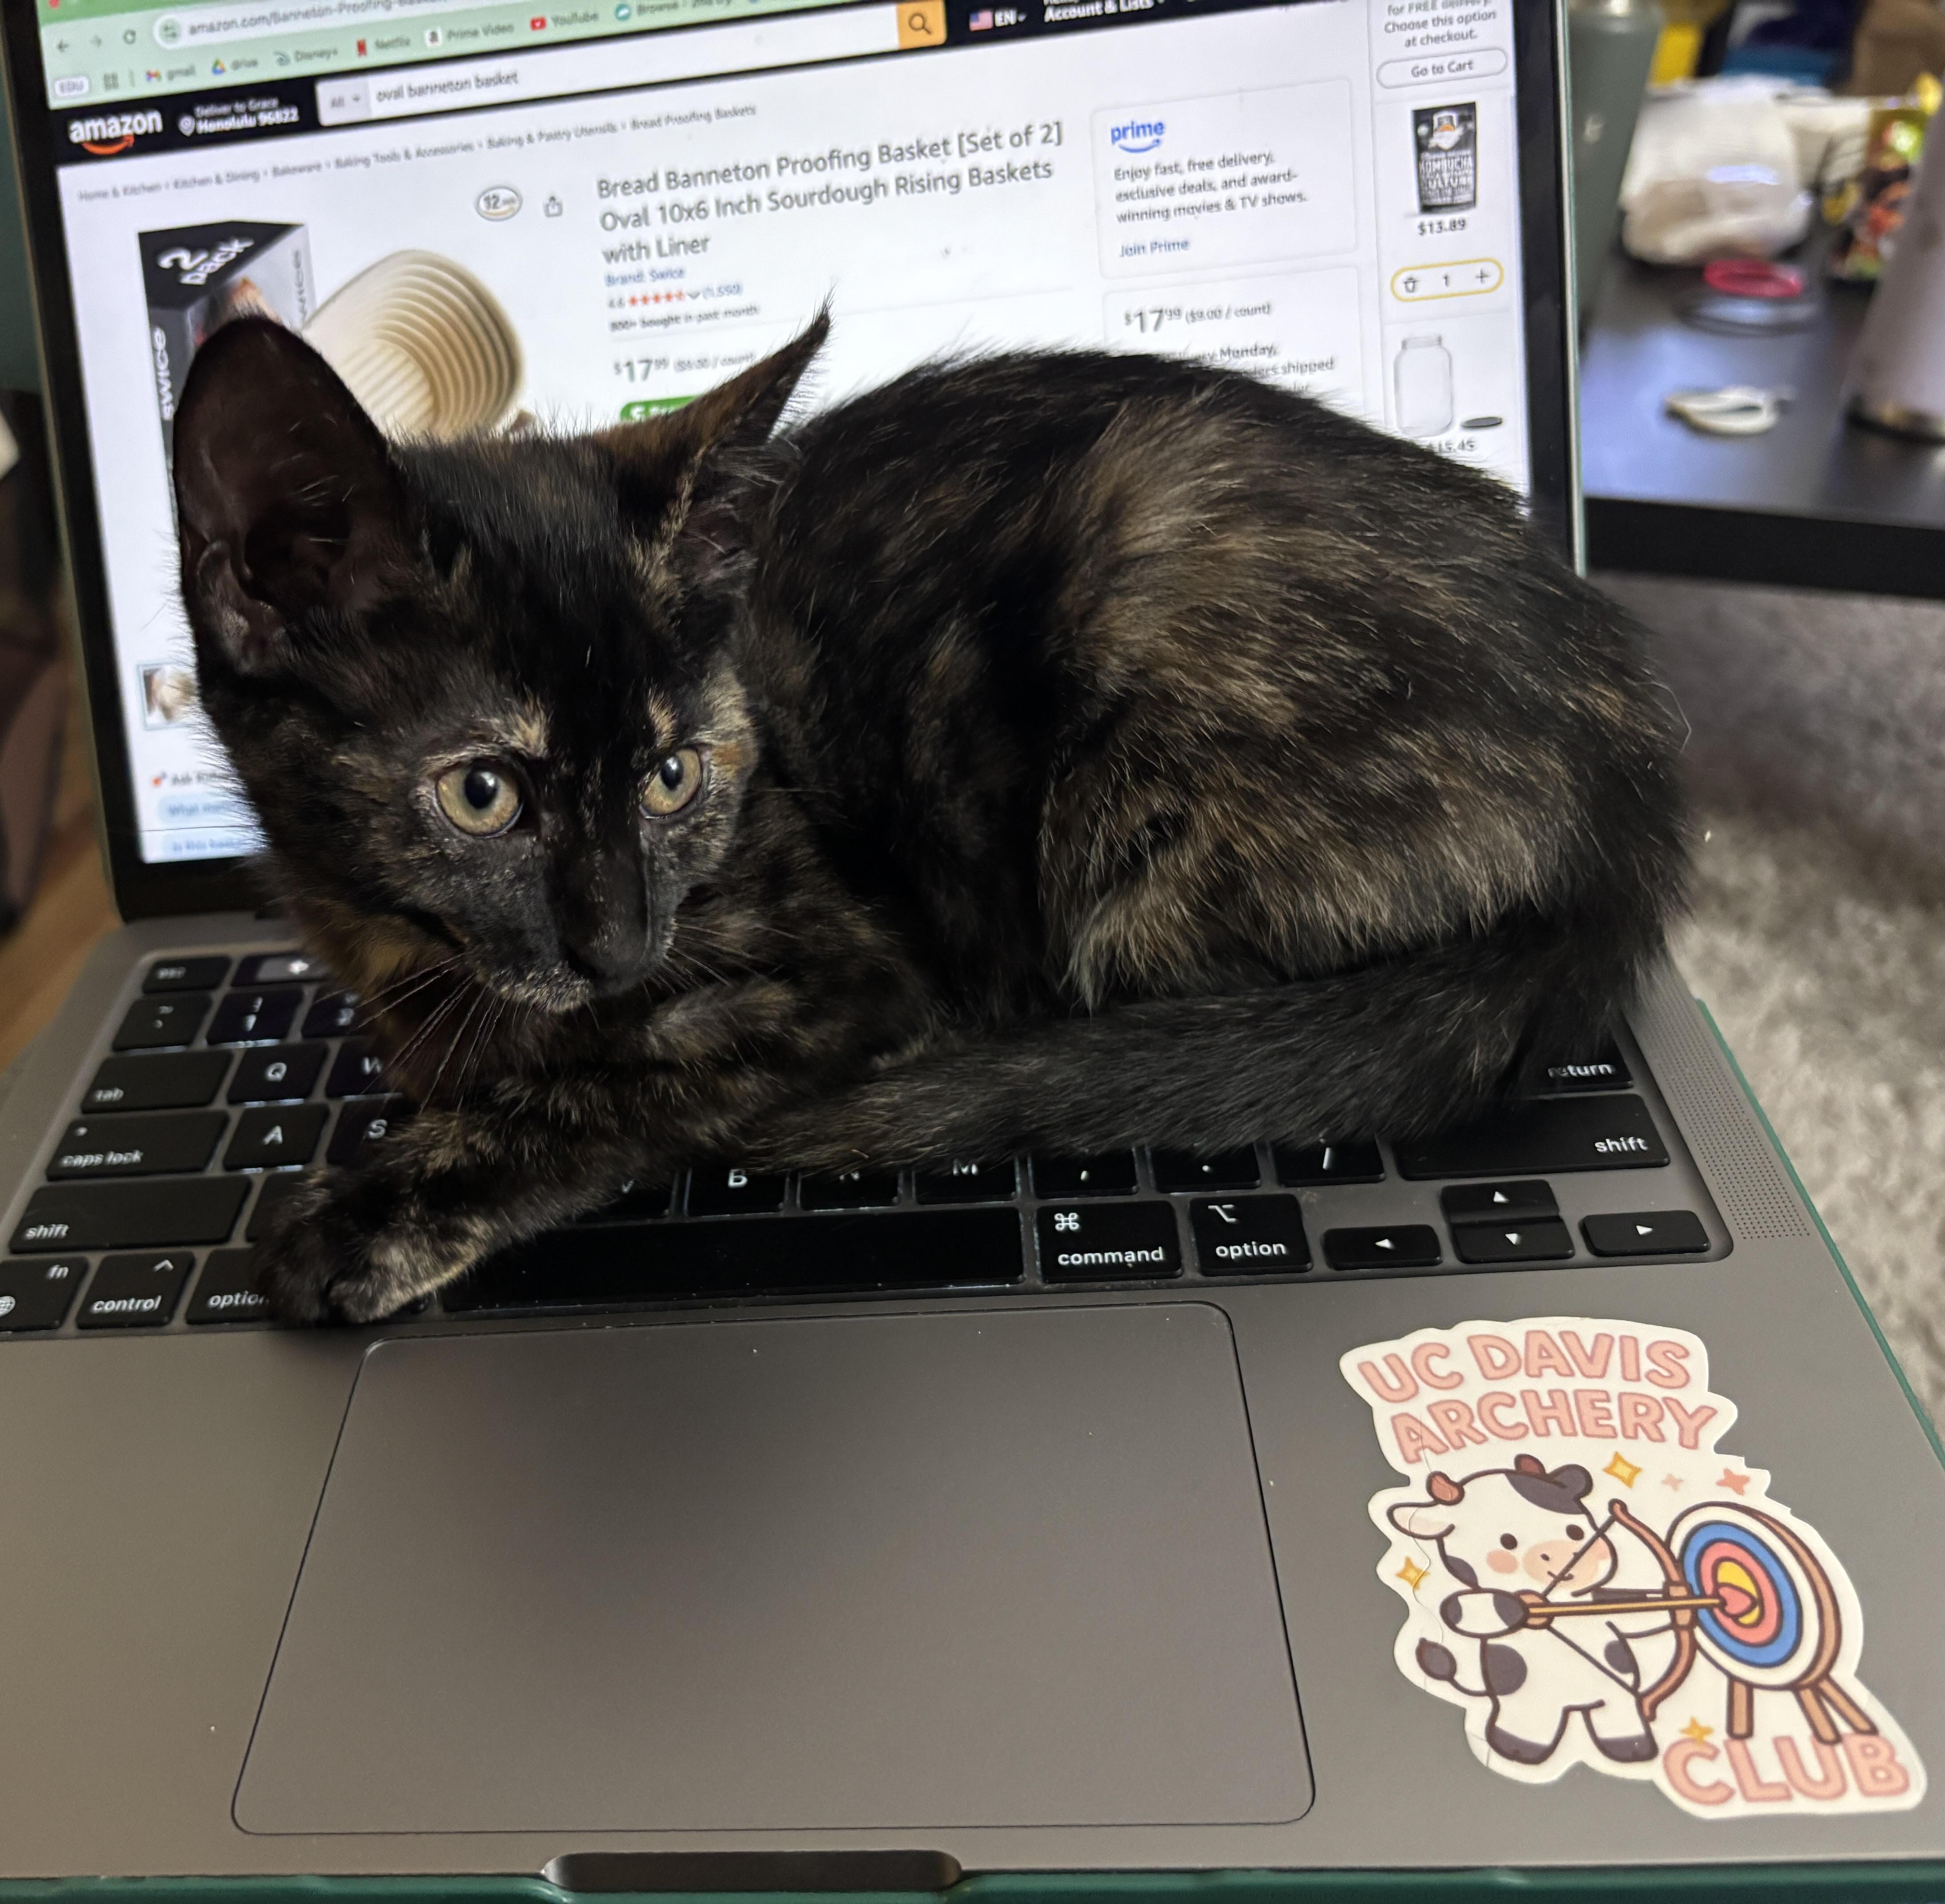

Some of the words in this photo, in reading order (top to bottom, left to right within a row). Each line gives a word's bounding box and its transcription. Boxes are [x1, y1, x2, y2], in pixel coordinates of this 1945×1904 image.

[994, 9, 1017, 27] EN
[1044, 2, 1103, 23] Account
[1105, 1, 1116, 14] &
[1387, 4, 1405, 16] for
[1408, 1, 1438, 14] FREE
[551, 12, 599, 27] YouTube
[1384, 19, 1428, 33] Choose
[1431, 15, 1454, 28] this
[1456, 10, 1497, 25] option
[446, 27, 479, 41] Prime
[480, 22, 514, 36] Video
[1404, 36, 1418, 48] at
[1419, 28, 1478, 46] checkout.
[1411, 64, 1428, 78] Go
[1431, 64, 1444, 75] to
[1447, 60, 1474, 73] Cart
[376, 87, 404, 103] oval
[406, 76, 473, 98] banneton
[474, 69, 519, 88] basket
[194, 103, 232, 117] Deliver
[233, 102, 246, 113] to
[68, 110, 163, 143] amazon
[196, 116, 257, 134] Honolulu
[1110, 119, 1165, 144] prime
[597, 172, 659, 199] Bread
[665, 160, 770, 189] Banneton
[777, 148, 871, 177] Proofing
[878, 137, 952, 164] Basket
[958, 131, 1002, 159] [Set
[1010, 125, 1034, 148] of
[1040, 120, 1063, 147] 2]
[1114, 167, 1151, 183] Enjoy
[1154, 162, 1182, 177] fast,
[1187, 158, 1214, 173] free
[1218, 150, 1275, 169] delivery,
[78, 189, 108, 202] Home
[122, 183, 162, 197] Kitchen
[173, 176, 213, 190] Kitchen
[225, 170, 260, 184] Dining
[1115, 184, 1175, 202] exclusive
[1178, 179, 1217, 197] deals,
[1221, 176, 1246, 191] and
[1250, 169, 1298, 187] award-
[483, 194, 500, 210] 12
[600, 206, 651, 232] Oval
[659, 200, 709, 224] 10x6
[715, 192, 762, 218] Inch
[767, 179, 888, 212] Sourdough
[895, 171, 962, 196] Rising
[968, 160, 1053, 188] Baskets
[1116, 206, 1170, 224] winning
[1173, 200, 1221, 216] movies
[1224, 197, 1235, 212] &
[1239, 195, 1258, 209] TV
[1261, 191, 1308, 206] shows.
[601, 240, 651, 264] with
[656, 234, 711, 258] Liner
[1119, 240, 1146, 258] Join
[1150, 238, 1190, 254] Prime
[158, 247, 208, 270] 2
[1443, 273, 1450, 288] 1
[639, 315, 682, 330] bought
[684, 313, 692, 323] in
[696, 311, 720, 324] past
[723, 304, 760, 316] month
[1234, 301, 1271, 318] count)
[1219, 343, 1277, 360] Monday,
[1282, 356, 1335, 376] shipped
[265, 1062, 287, 1081] Q
[1548, 1063, 1616, 1079] return
[94, 1087, 124, 1103] tab
[262, 1125, 284, 1145] A
[367, 1119, 388, 1139] S
[1594, 1136, 1649, 1154] shift
[61, 1152, 104, 1168] caps
[106, 1149, 144, 1164] lock
[727, 1168, 748, 1188] B
[25, 1224, 69, 1240] shift
[1057, 1246, 1165, 1267] command
[1215, 1241, 1287, 1260] option
[46, 1264, 69, 1280] fn
[93, 1295, 162, 1313] control
[1357, 1341, 1464, 1404] UC
[1466, 1329, 1691, 1390] DAVIS
[1390, 1388, 1718, 1464] ARCHERY
[1662, 1730, 1911, 1806] CLUB
